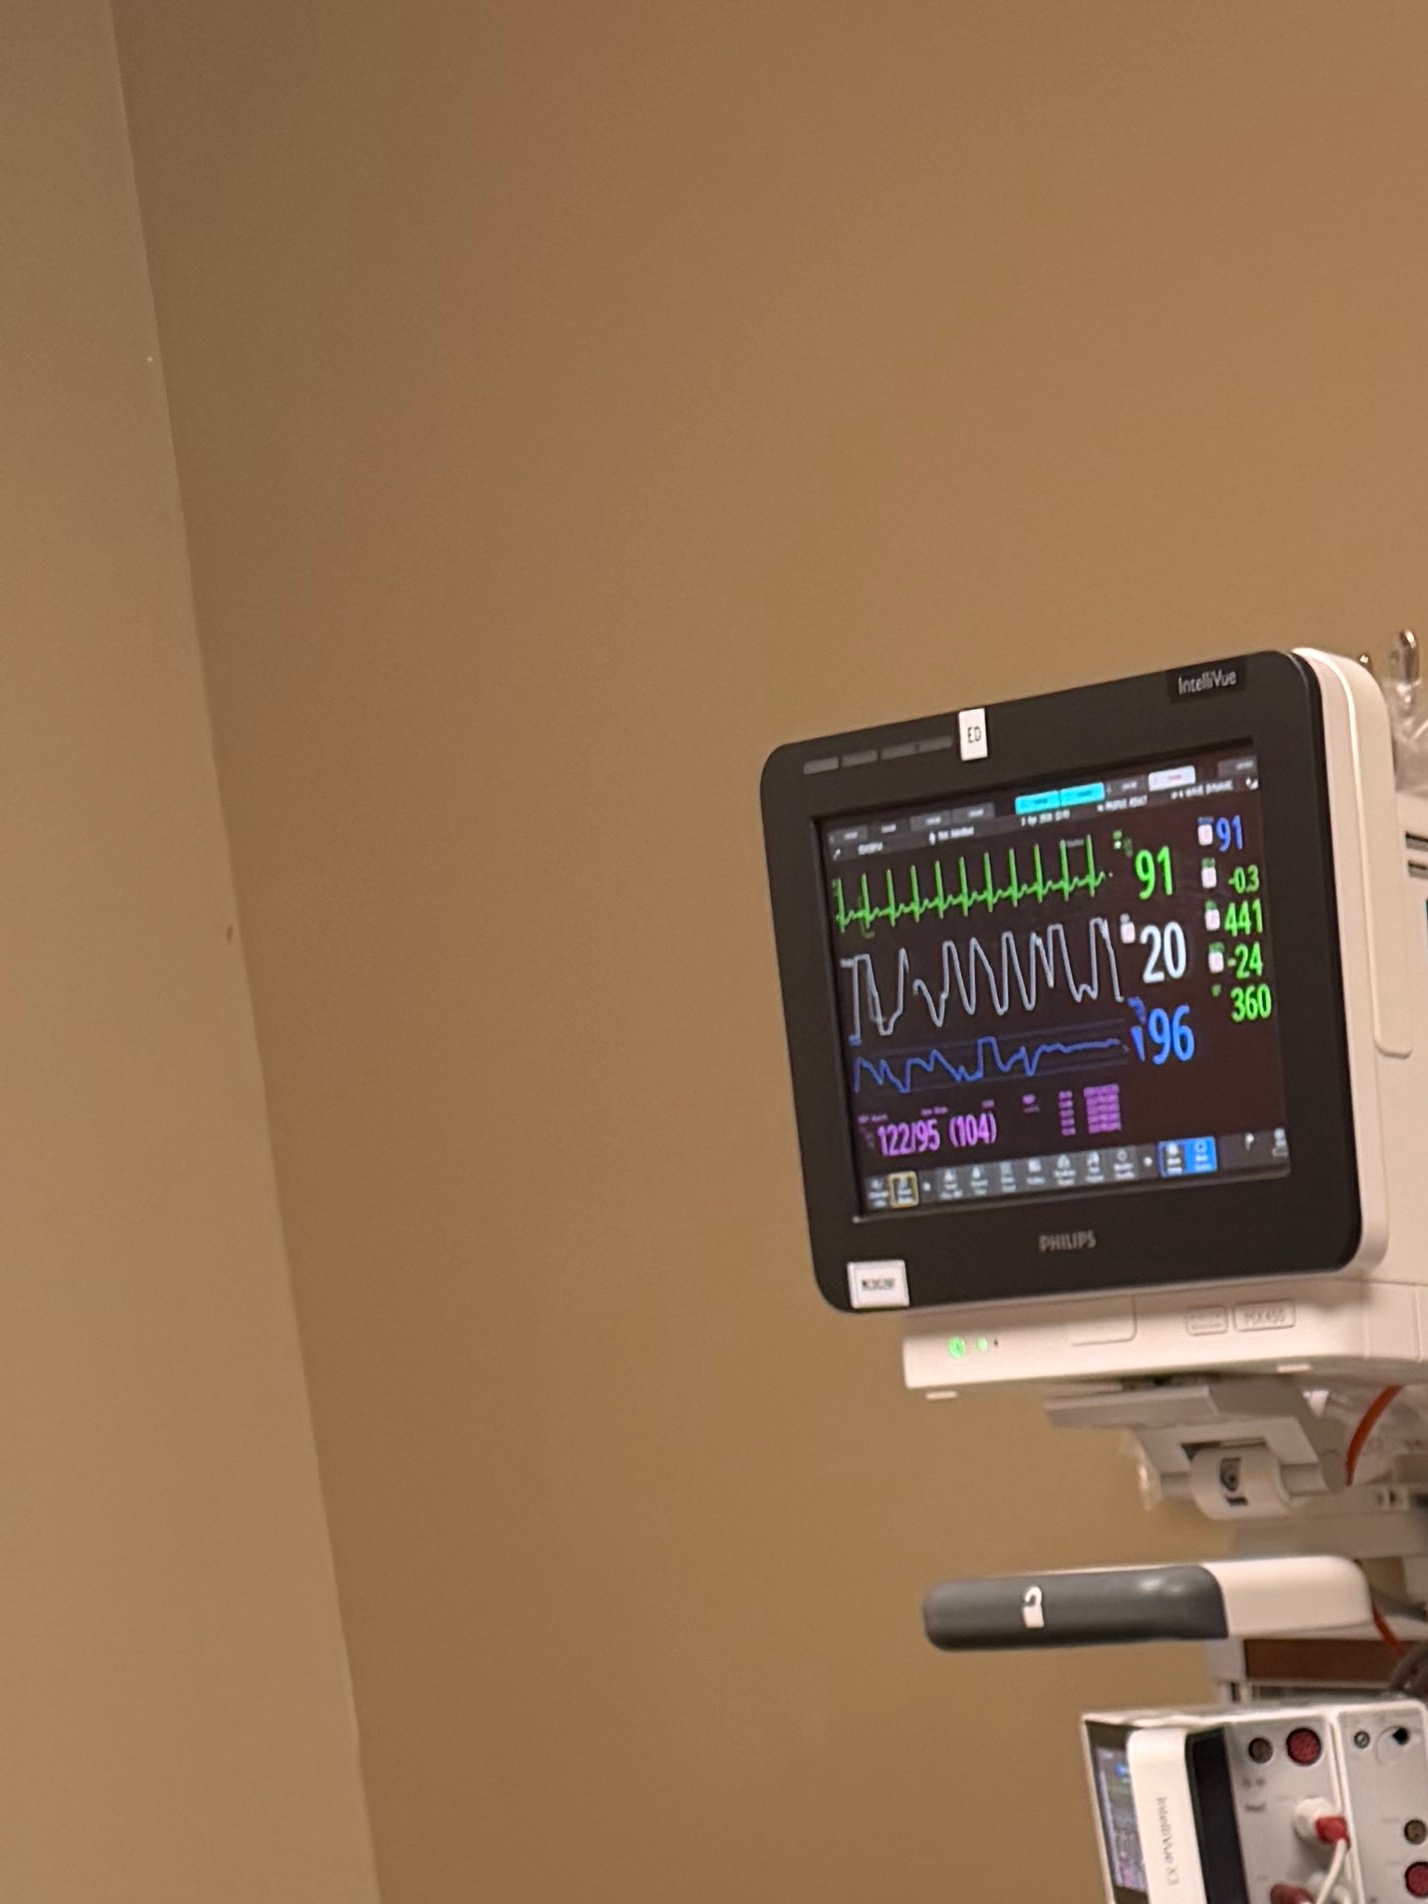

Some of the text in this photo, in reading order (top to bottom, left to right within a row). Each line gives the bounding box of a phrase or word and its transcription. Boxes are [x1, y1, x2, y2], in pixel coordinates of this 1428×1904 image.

[1178, 668, 1237, 695] IntelliVue
[1215, 815, 1244, 852] 91
[1135, 846, 1173, 900] 91
[1224, 899, 1263, 936] 441
[1140, 921, 1186, 983] 20
[1227, 942, 1263, 979] -24
[1230, 984, 1271, 1022] 360
[1148, 1004, 1195, 1065] 96
[877, 1112, 997, 1157] 122/95 (104)
[1038, 1230, 1096, 1252] PHILIPS
